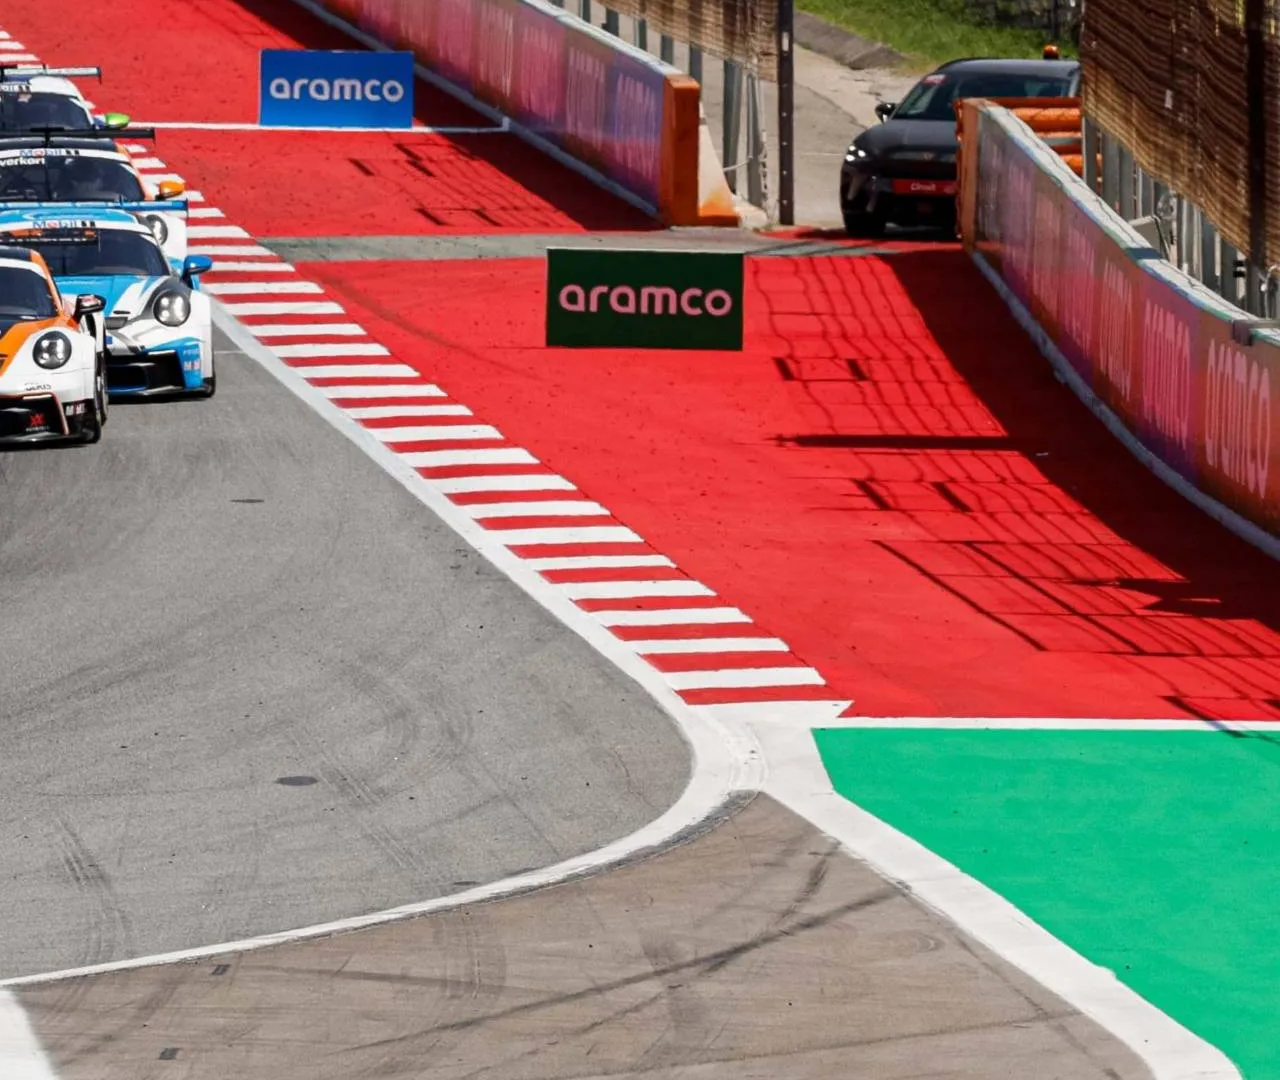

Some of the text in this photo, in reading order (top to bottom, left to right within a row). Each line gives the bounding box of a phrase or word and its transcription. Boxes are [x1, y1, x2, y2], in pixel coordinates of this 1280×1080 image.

[269, 75, 404, 103] aramco
[32, 220, 78, 229] Mobil
[558, 283, 733, 317] aramco
